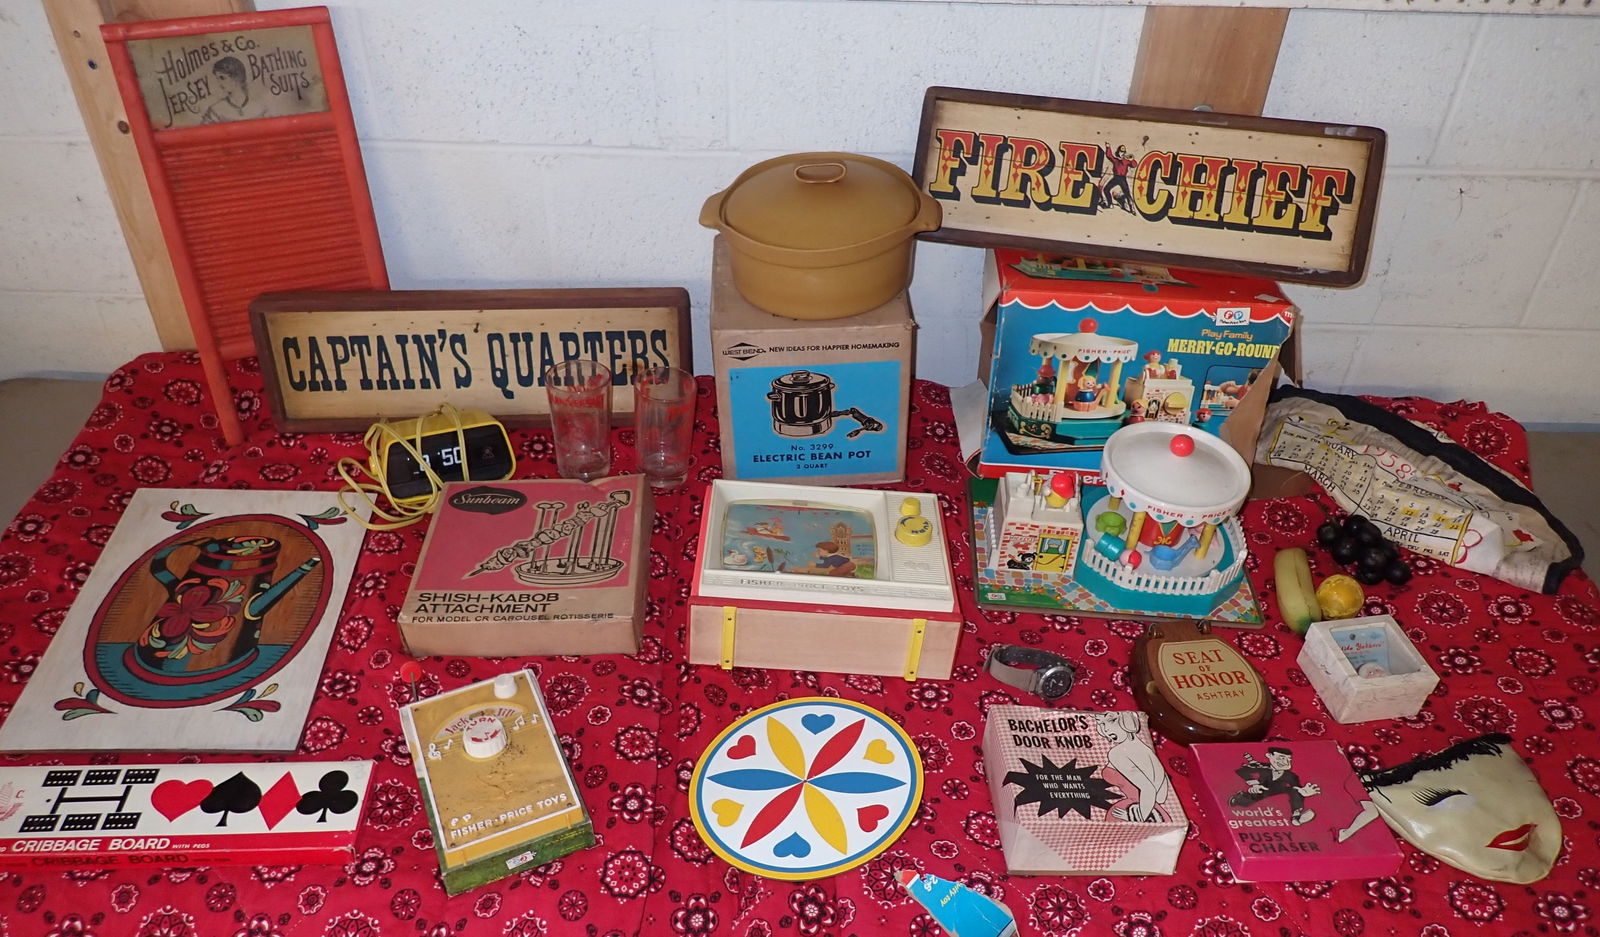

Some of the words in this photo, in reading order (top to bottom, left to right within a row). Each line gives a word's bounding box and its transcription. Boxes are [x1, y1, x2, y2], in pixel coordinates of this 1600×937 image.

[156, 42, 219, 85] Holmes
[222, 40, 235, 53] &
[235, 36, 260, 51] Co.
[248, 47, 307, 86] BATHING
[270, 72, 310, 101] SUITS
[158, 75, 212, 128] JERSEY
[928, 128, 1106, 215] FIRE
[1133, 151, 1356, 241] CHIEF
[1201, 329, 1222, 340] Play
[1223, 330, 1253, 342] Family
[851, 342, 900, 350] HOMEMAKING
[283, 329, 472, 392] CAPTAIN'S
[487, 329, 670, 400] QUARTERS
[791, 444, 806, 452] No.
[753, 453, 806, 463] ELECTRIC
[810, 451, 843, 461] BEAN
[848, 450, 872, 459] POT
[1304, 464, 1336, 492] MARCH
[453, 493, 521, 505] Sunbeam
[1147, 505, 1184, 518] FISHER
[1384, 527, 1420, 543] APRIL
[418, 592, 560, 603] SHISH-KABOB
[415, 602, 551, 614] ATTACHMENT
[436, 615, 471, 623] MODEL
[493, 614, 551, 622] CAROUSEL
[553, 613, 614, 621] ROTISSERIE
[1172, 649, 1224, 665] SEAT
[1198, 664, 1211, 673] OF
[1172, 670, 1251, 689] HONOR
[1196, 689, 1246, 701] ASHTRAY
[445, 718, 469, 734] Jack
[497, 708, 515, 718] Jill
[466, 717, 496, 732] TURN
[1007, 714, 1089, 734] BACHELOR'S
[1013, 734, 1054, 749] DOOR
[1054, 734, 1093, 750] KNOB
[1035, 773, 1049, 781] FOR
[1051, 773, 1064, 782] THE
[537, 793, 568, 809] TOYS
[1049, 791, 1091, 800] EVERYTHING
[1232, 806, 1283, 818] world's
[1228, 818, 1290, 830] greatest
[1239, 831, 1294, 843] PUSSY
[12, 838, 103, 853] CRIBBAGE
[108, 838, 171, 851] BOARD
[1249, 842, 1320, 854] CHASER
[31, 856, 119, 867] CRIBBAGE
[128, 854, 189, 864] BOARD
[940, 895, 951, 908] toy
